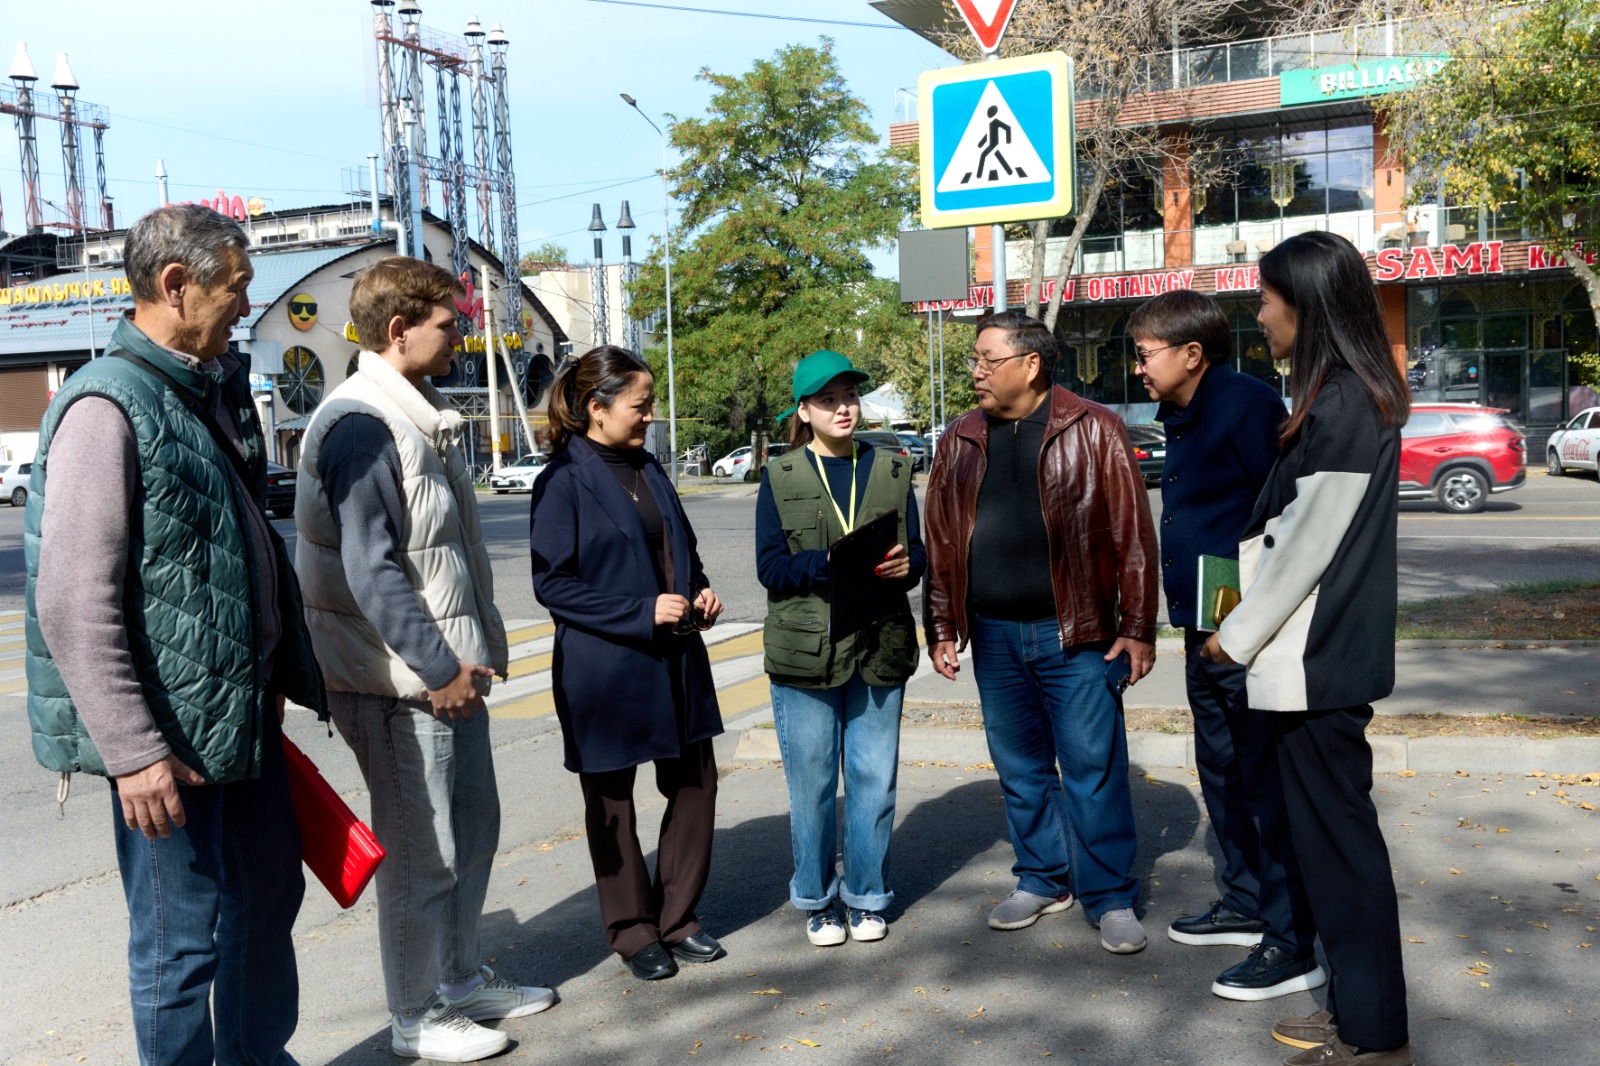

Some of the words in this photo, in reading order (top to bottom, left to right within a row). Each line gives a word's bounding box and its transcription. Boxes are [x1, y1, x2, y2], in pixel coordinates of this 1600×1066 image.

[1376, 240, 1503, 281] SAMI
[0, 279, 106, 305] ШАШЛЫЧОК
[1087, 270, 1194, 301] ORTALYGY
